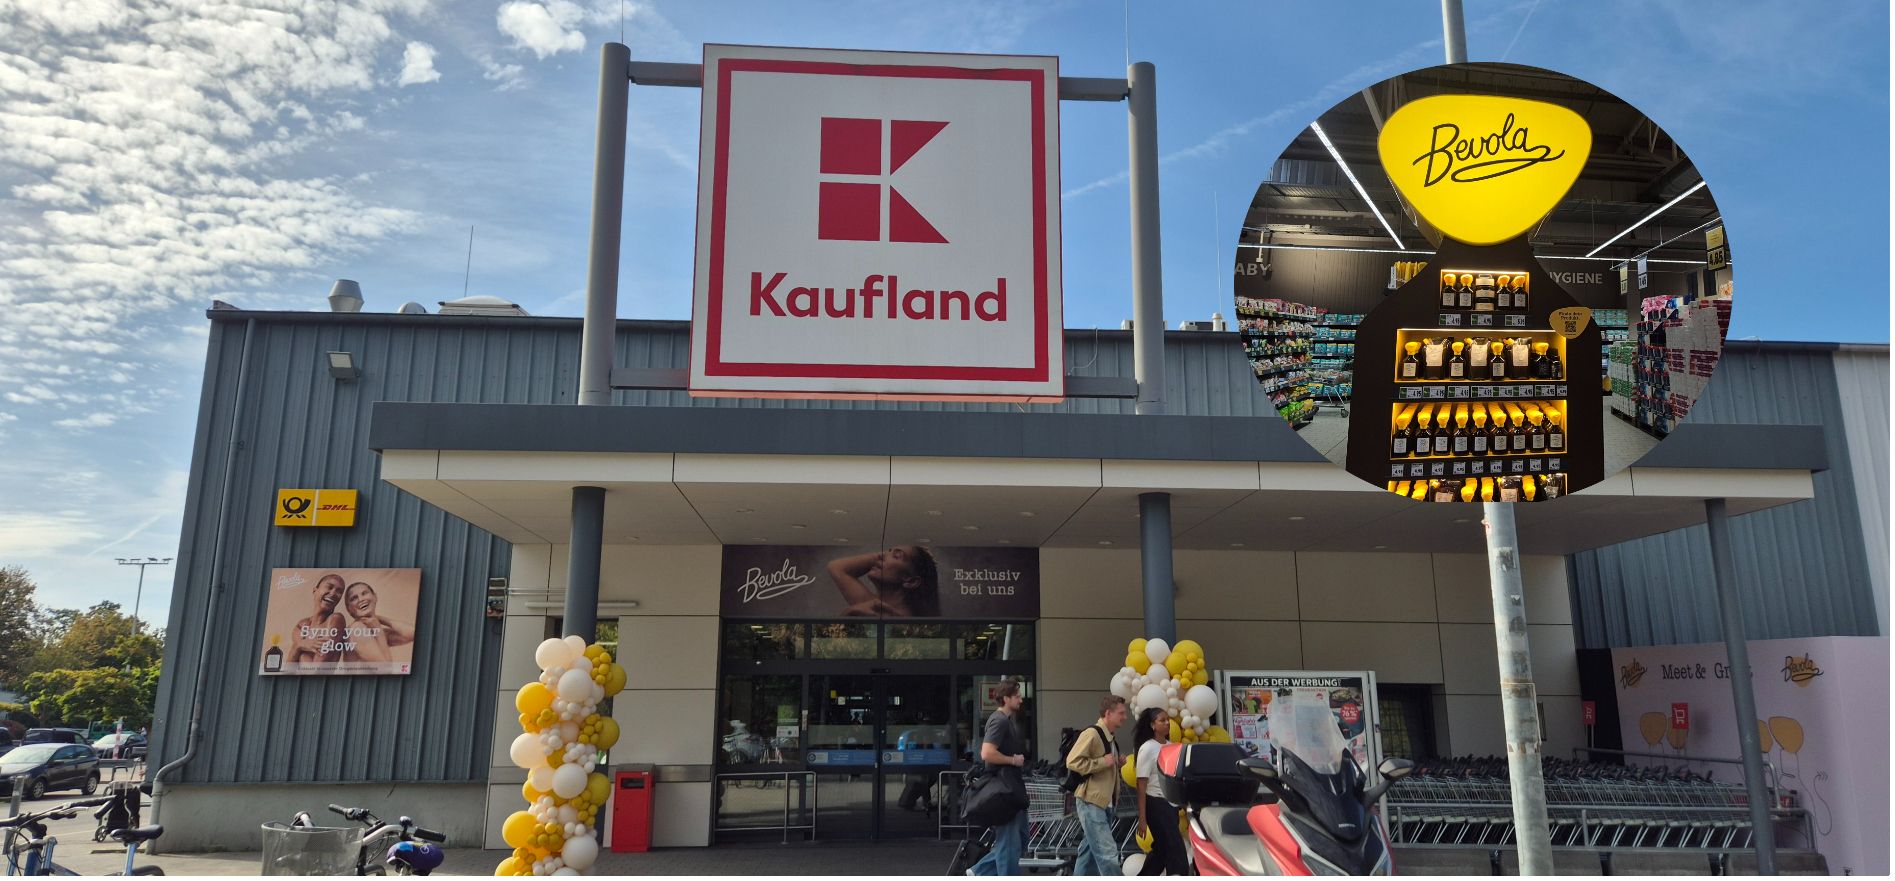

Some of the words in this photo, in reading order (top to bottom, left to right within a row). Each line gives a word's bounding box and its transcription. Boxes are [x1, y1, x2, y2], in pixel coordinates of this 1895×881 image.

[1413, 113, 1565, 187] Bevola
[750, 271, 1007, 322] Kaufland
[738, 558, 816, 603] Bevola
[953, 568, 1021, 581] Exklusiv
[960, 583, 983, 595] bei
[988, 585, 1015, 595] uns
[300, 625, 338, 640] Sync
[343, 626, 381, 640] your
[320, 640, 357, 656] glow
[1661, 664, 1693, 680] Meet
[1695, 663, 1706, 680] &
[1251, 678, 1269, 686] AUS
[1271, 678, 1289, 686] DER
